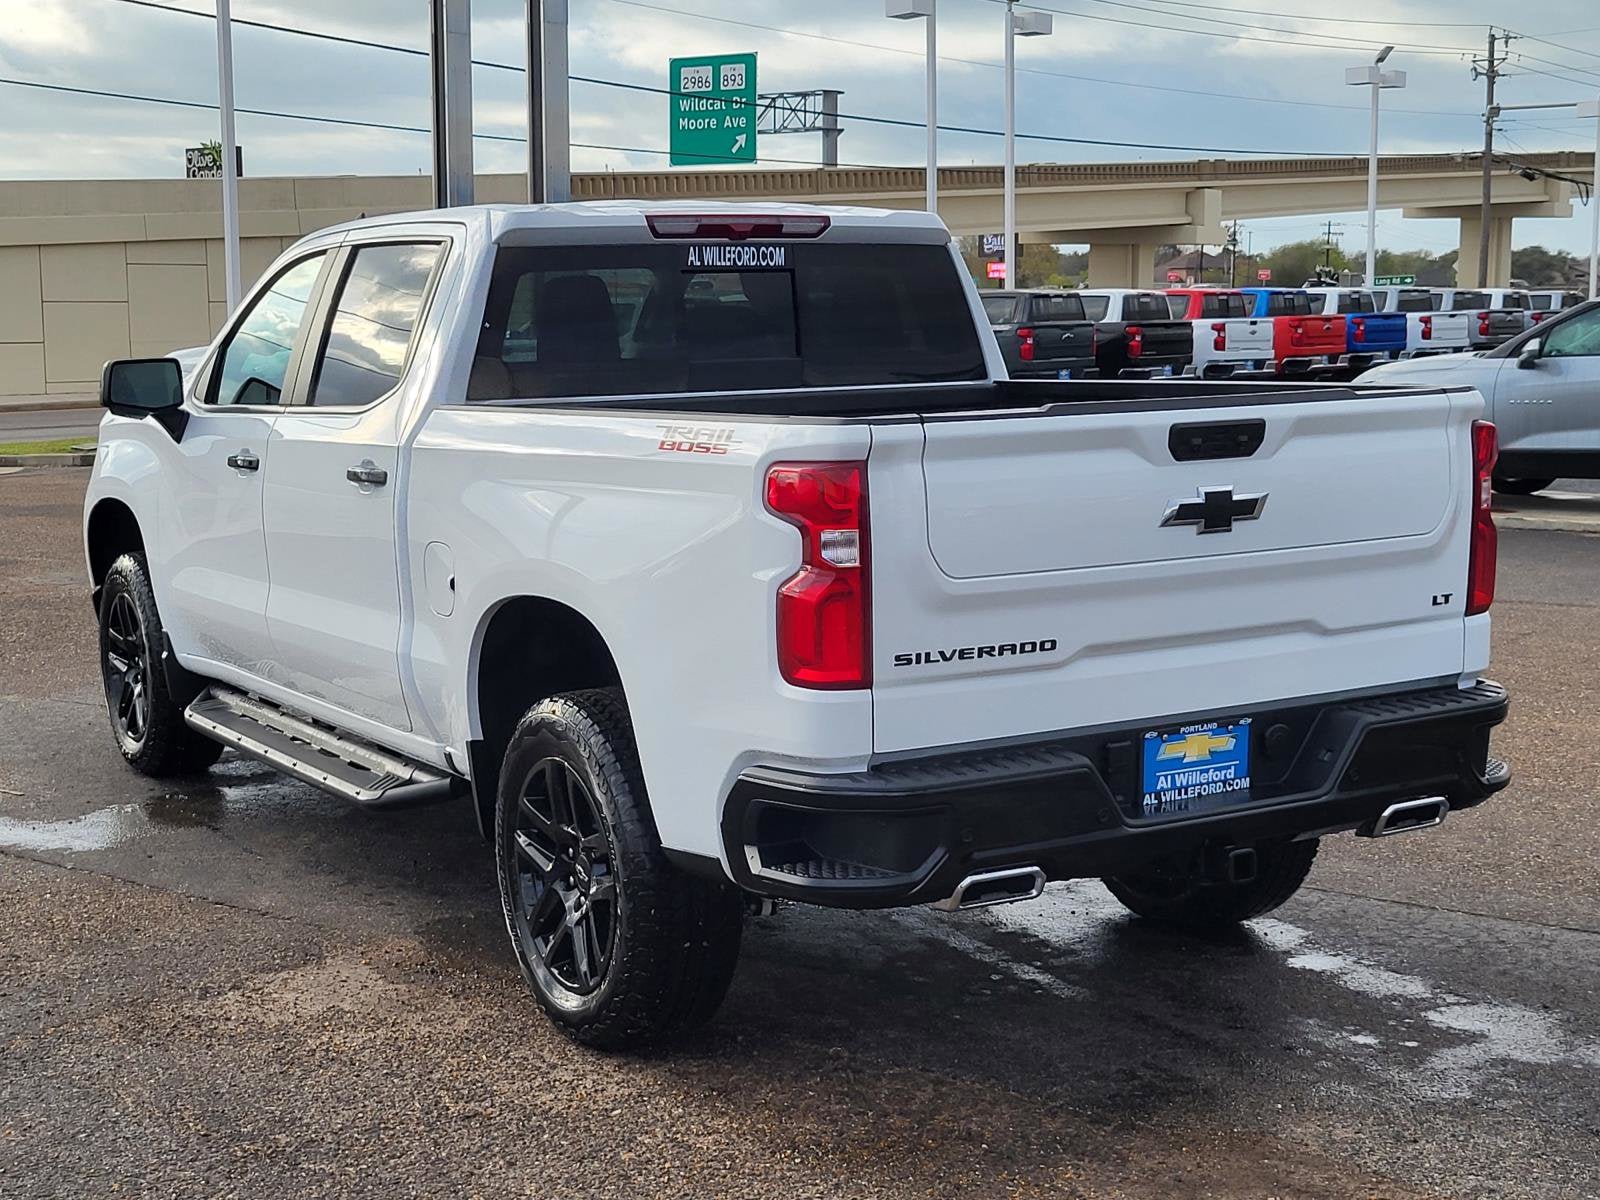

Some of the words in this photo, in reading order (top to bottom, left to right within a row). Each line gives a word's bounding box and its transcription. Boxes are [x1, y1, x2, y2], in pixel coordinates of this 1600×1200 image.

[683, 75, 711, 89] 2986
[723, 73, 744, 87] 893
[679, 97, 726, 111] Wildcat
[732, 96, 747, 109] Dr
[679, 117, 717, 130] Moore
[724, 115, 747, 128] Ave
[187, 150, 214, 168] Olive
[190, 166, 223, 178] Garde
[688, 247, 701, 266] AL
[703, 246, 785, 266] WILLEFORD.COM
[656, 425, 743, 443] TRAIL
[658, 440, 729, 454] BOSS
[1432, 593, 1453, 606] LT
[894, 639, 1057, 667] SILVERADO
[1180, 722, 1218, 734] PORTLAND
[1157, 775, 1172, 790] Al
[1175, 765, 1235, 787] Willeford
[1143, 793, 1158, 805] AL
[1160, 777, 1250, 803] WILLEFORD.COM
